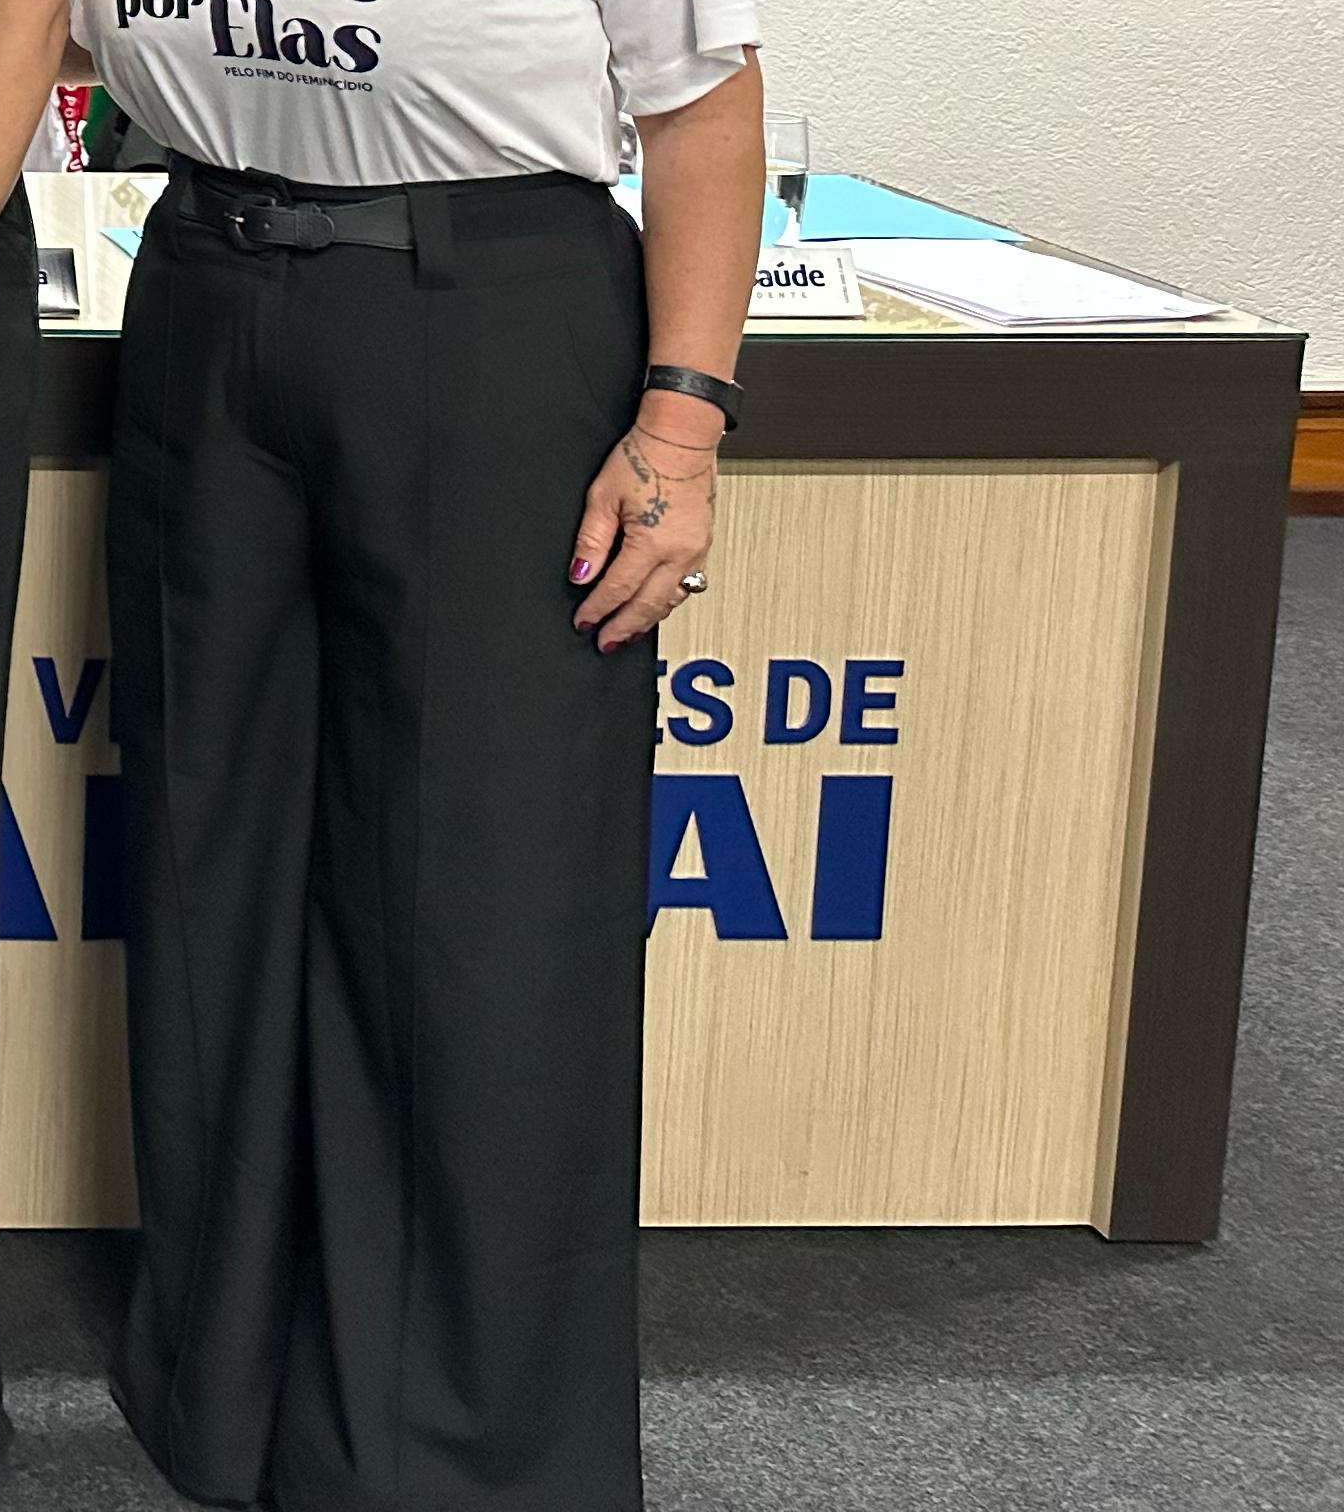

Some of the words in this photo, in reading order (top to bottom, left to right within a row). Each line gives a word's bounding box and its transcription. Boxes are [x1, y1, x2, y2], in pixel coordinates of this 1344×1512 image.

[224, 66, 254, 77] PELO
[255, 68, 275, 79] FIM
[277, 71, 294, 82] DO
[754, 261, 825, 287] aúde
[764, 659, 905, 745] DE
